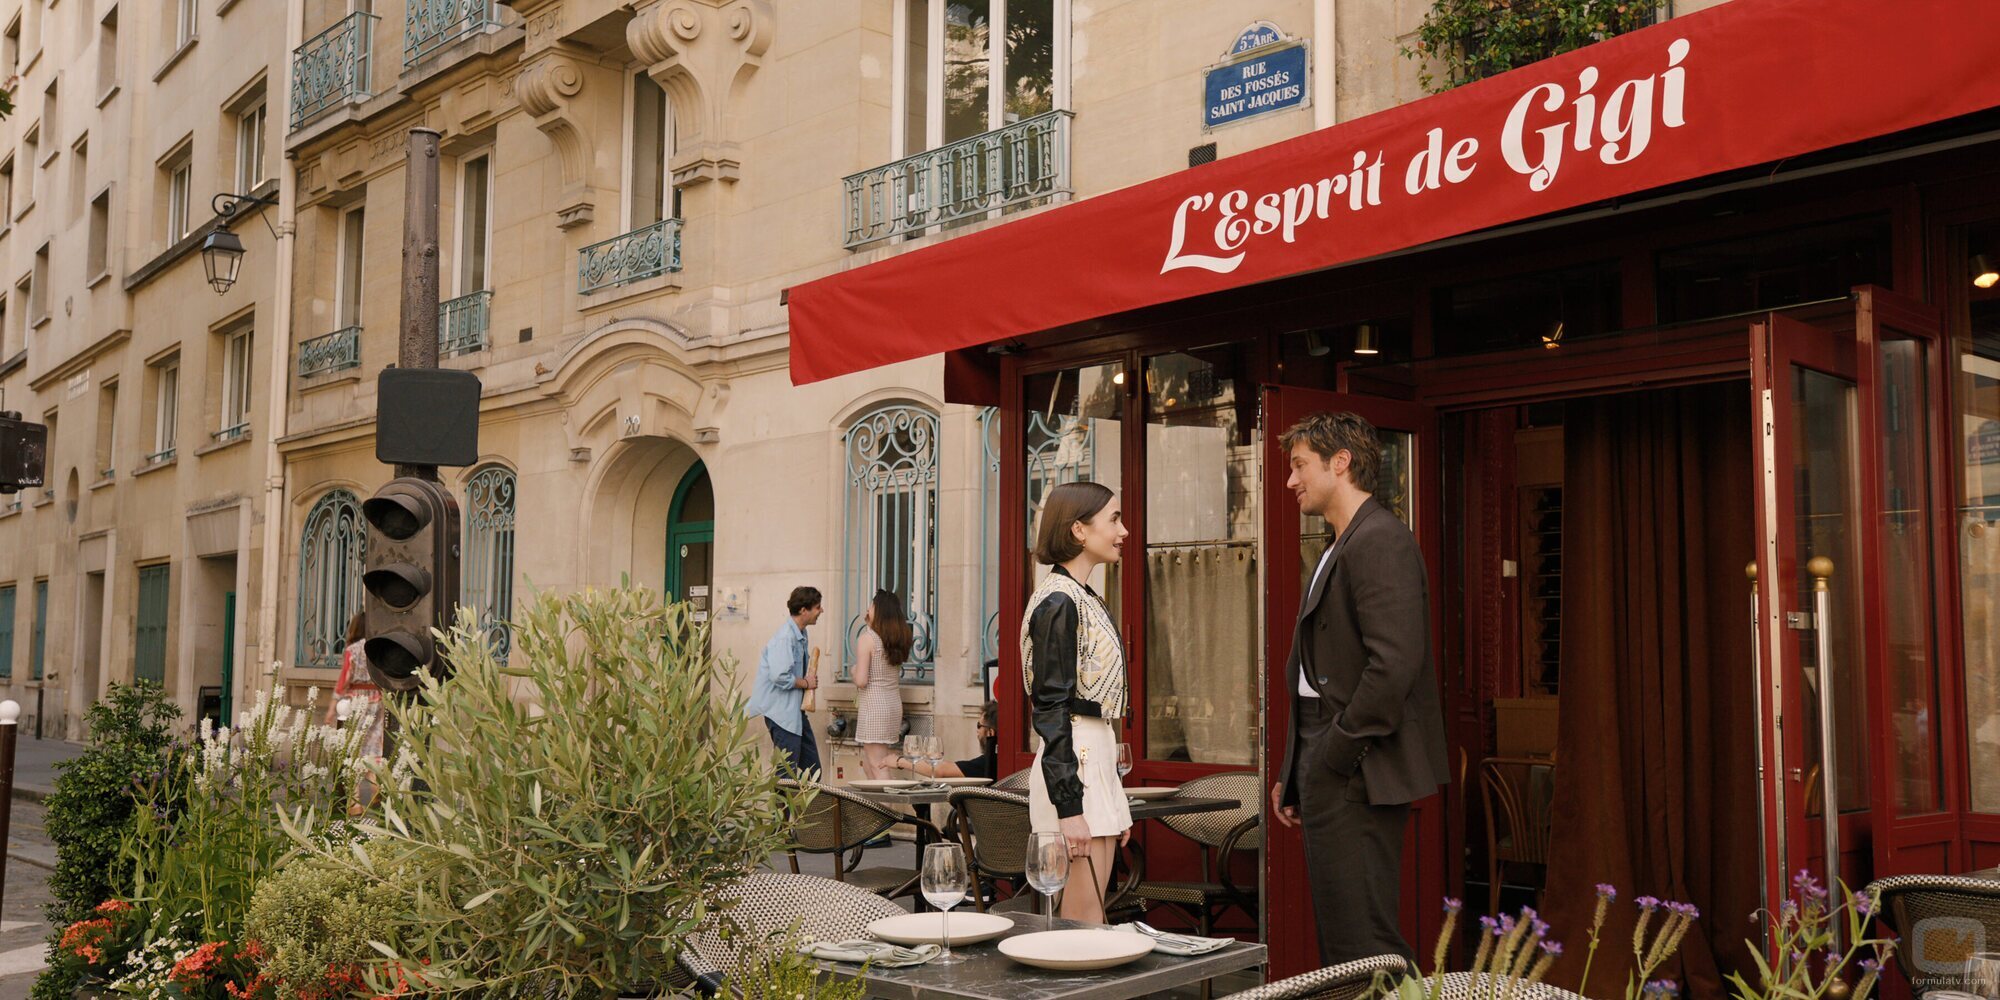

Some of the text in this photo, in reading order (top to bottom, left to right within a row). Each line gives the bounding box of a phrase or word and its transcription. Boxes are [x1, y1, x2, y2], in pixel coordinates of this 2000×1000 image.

[1220, 70, 1290, 101] DES FOSSÉS
[1242, 61, 1267, 80] RUE
[1211, 84, 1300, 119] SAINT JACQUES
[1160, 38, 1690, 275] L'Esprit de Gigi
